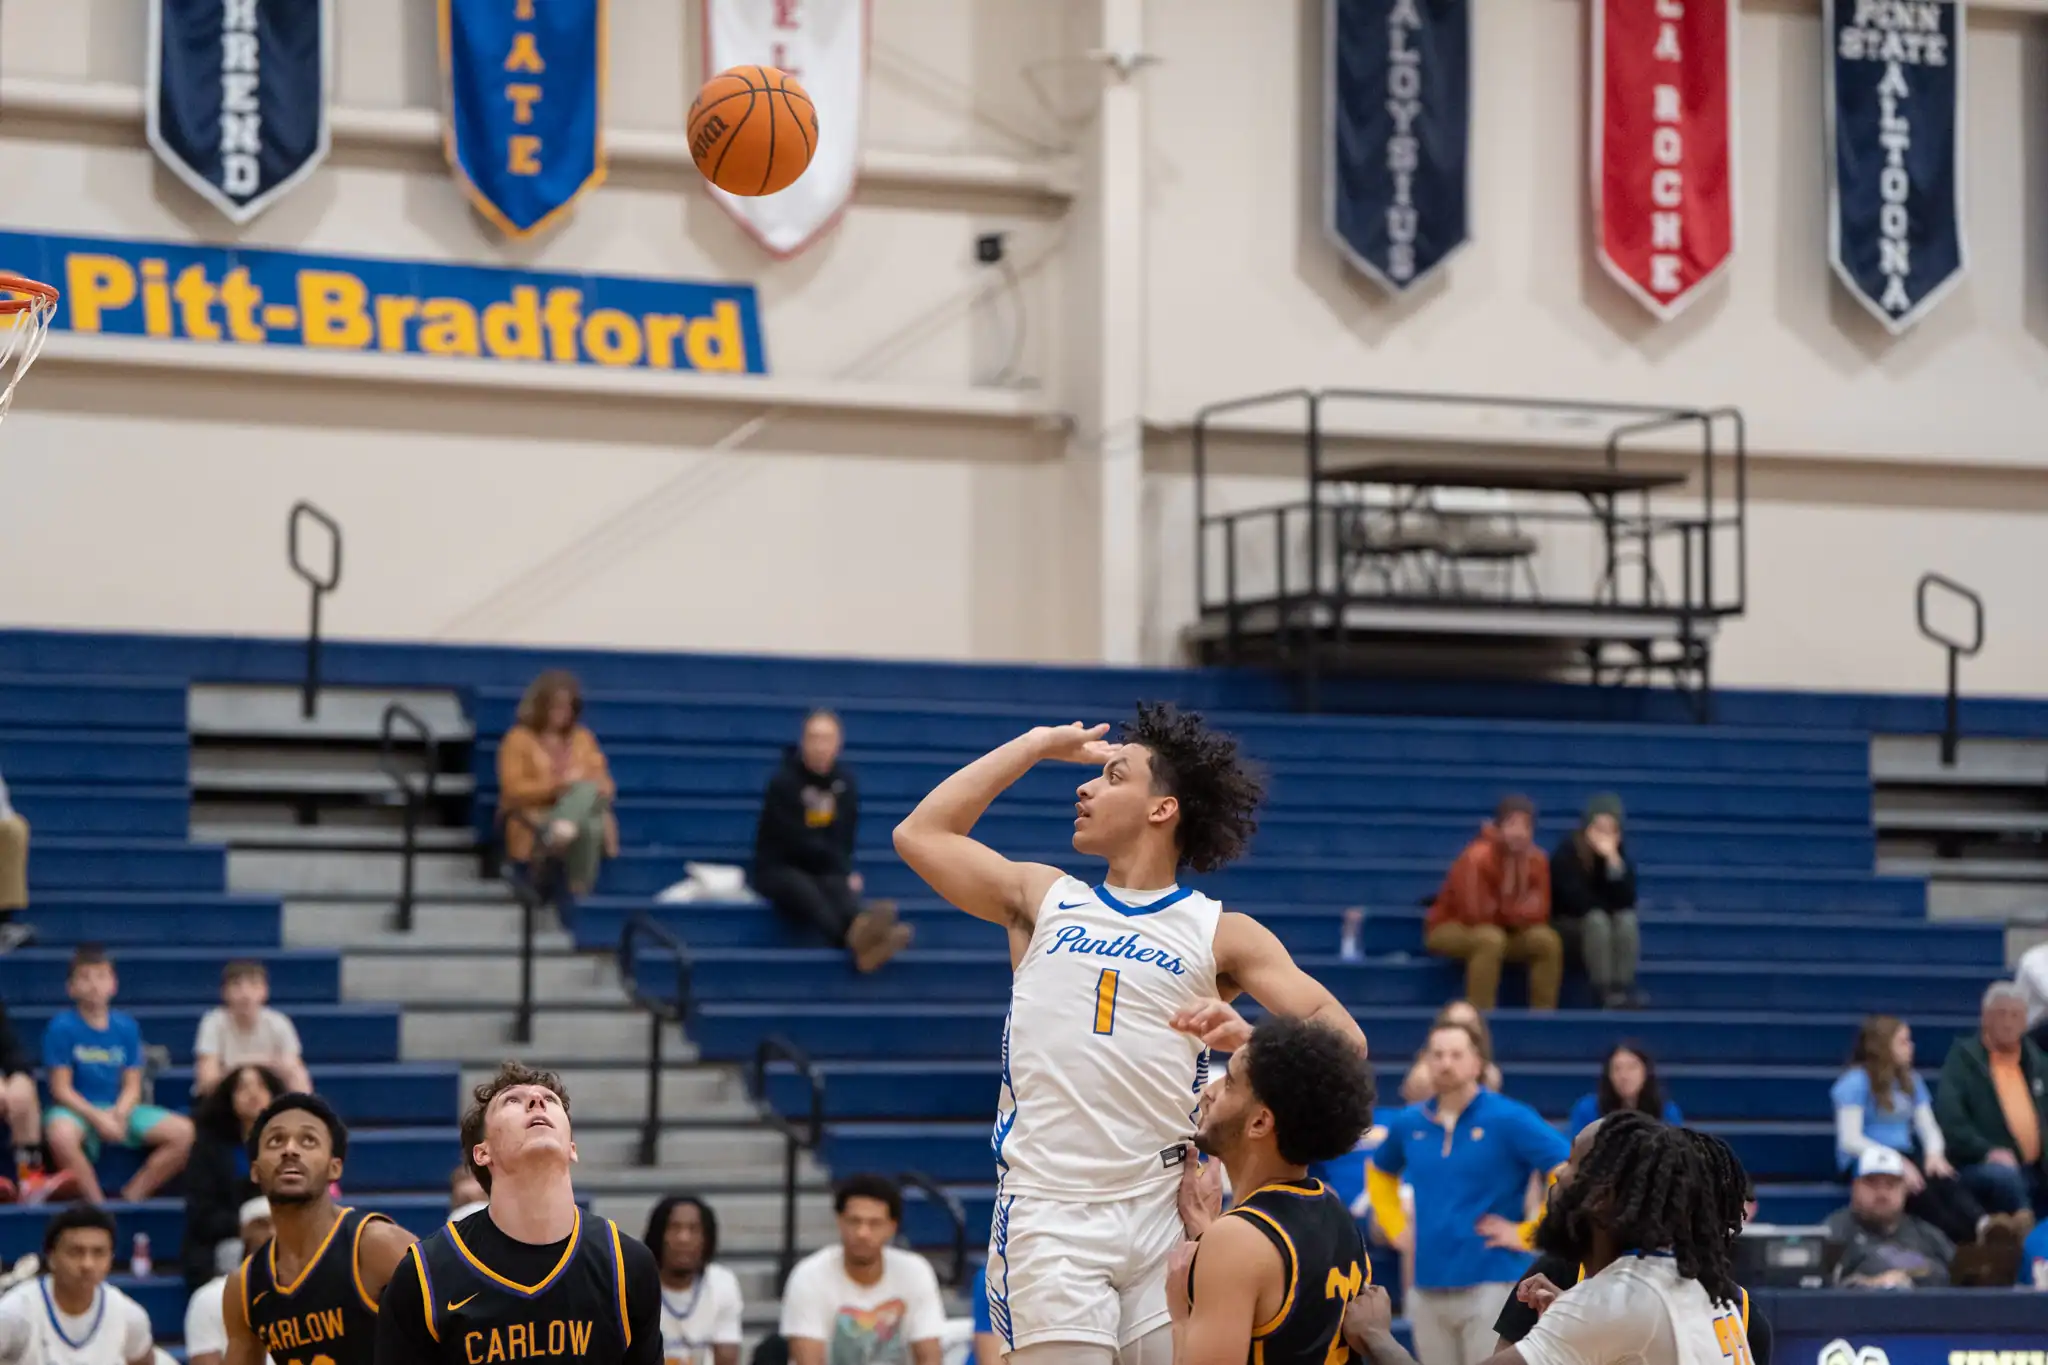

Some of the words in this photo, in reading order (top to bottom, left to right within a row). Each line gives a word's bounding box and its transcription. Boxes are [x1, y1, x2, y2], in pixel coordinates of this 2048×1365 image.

[1853, 0, 1943, 31] PENN
[1838, 26, 1948, 66] STATE
[1652, 84, 1682, 292] ROCHE
[1877, 61, 1911, 312] ALTOONA
[65, 252, 746, 373] Pitt-Bradford
[1047, 925, 1186, 976] Panthers
[1093, 967, 1121, 1036] 1
[464, 1319, 593, 1365] CARLOW
